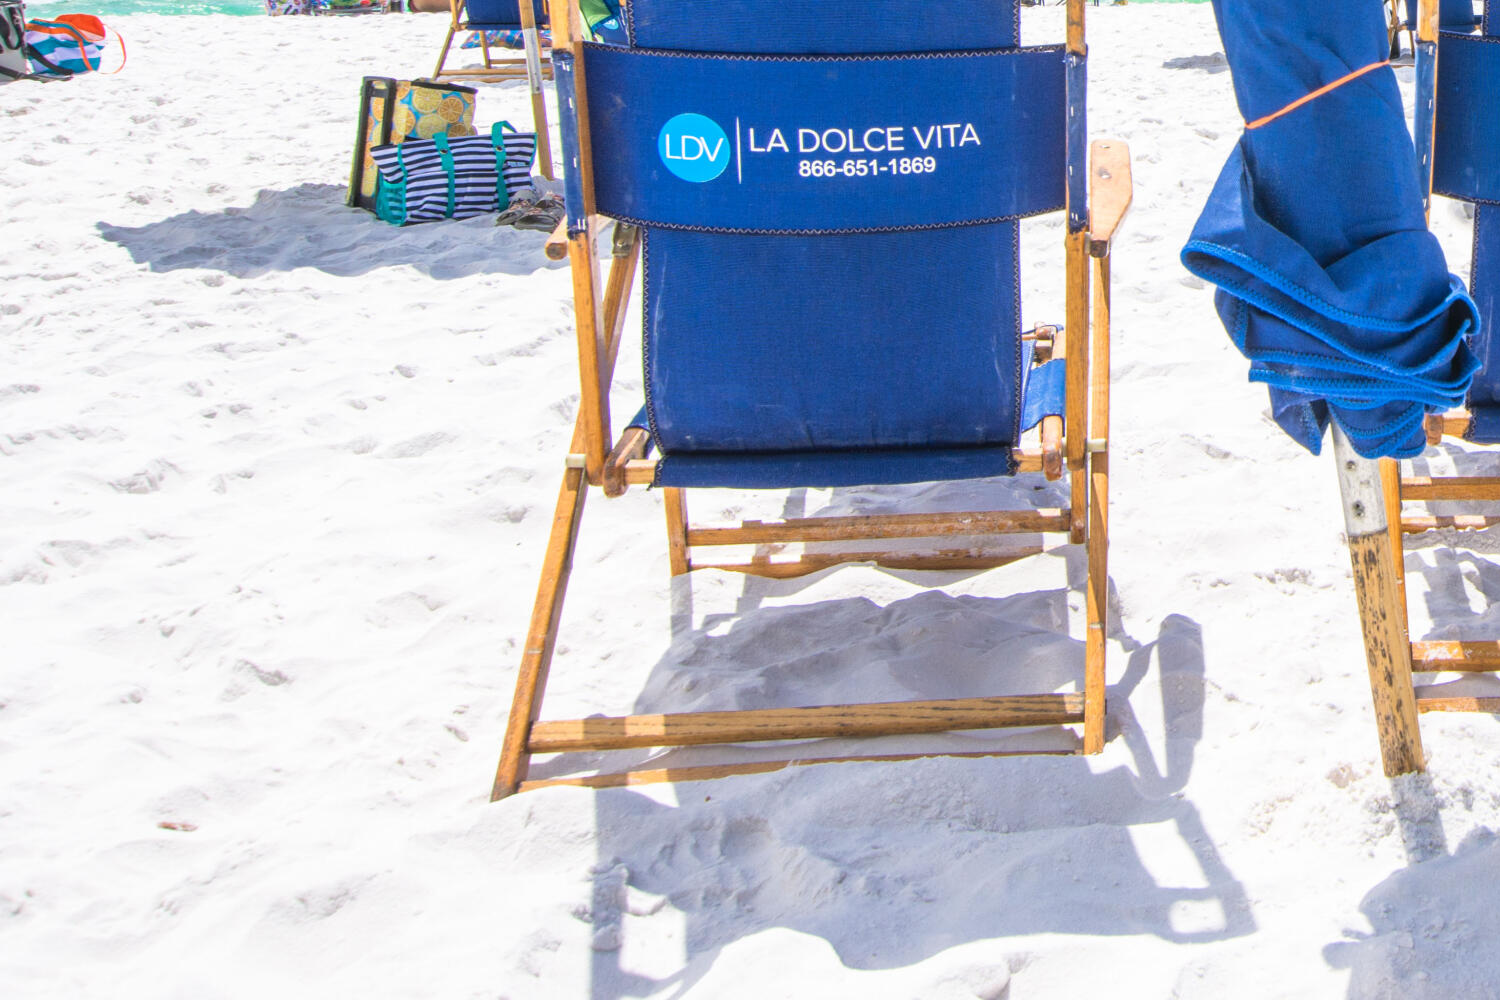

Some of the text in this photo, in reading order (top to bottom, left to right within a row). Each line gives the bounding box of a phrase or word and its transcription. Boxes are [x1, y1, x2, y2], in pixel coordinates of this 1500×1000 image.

[665, 132, 724, 163] LDV
[748, 122, 982, 153] LA DOLCE VITA
[798, 156, 937, 177] 866-651-1869
